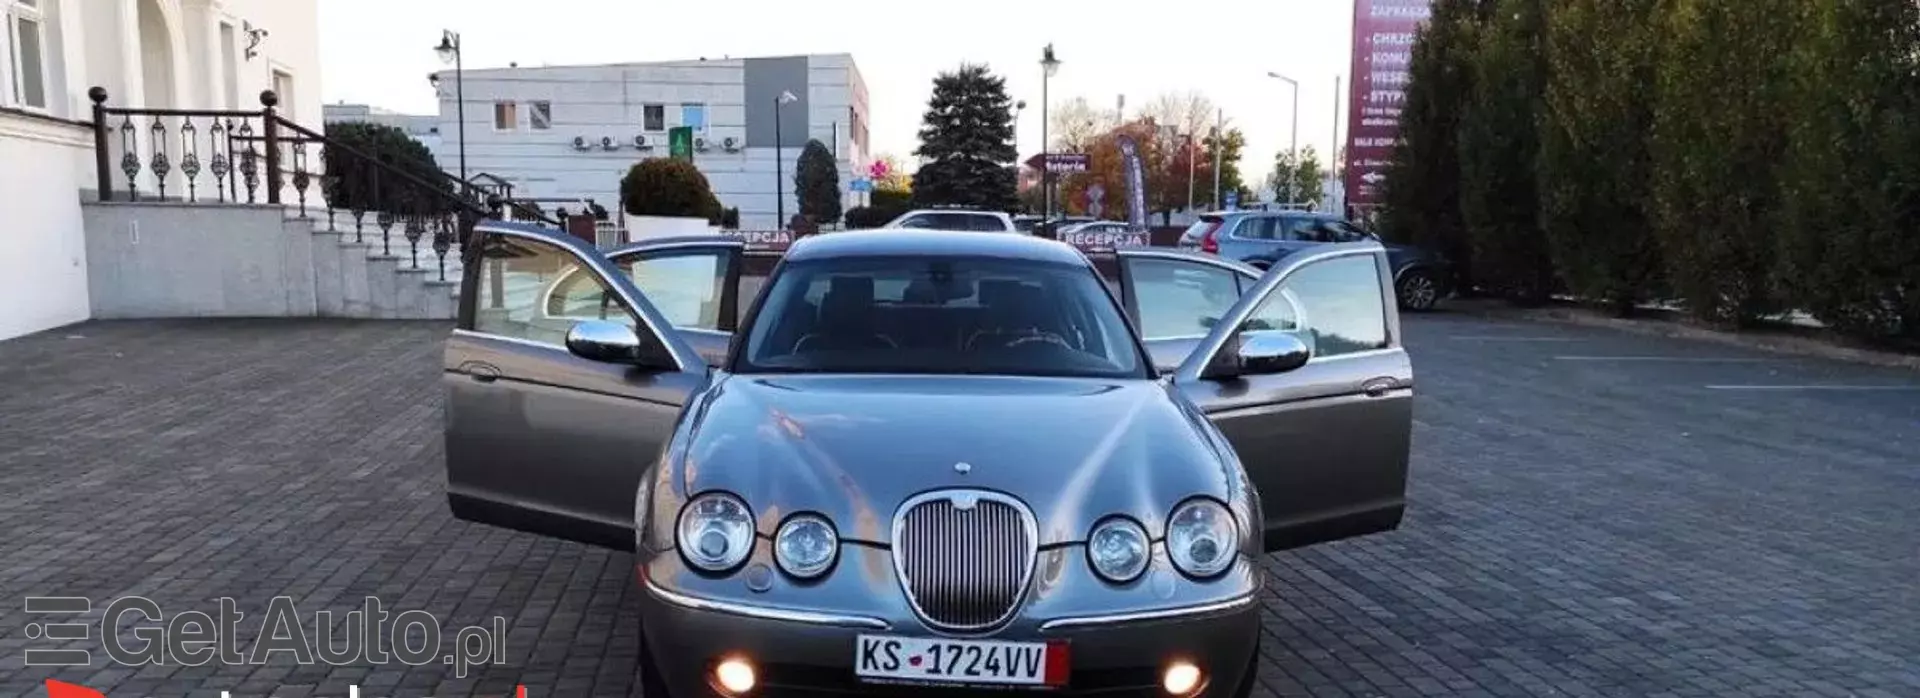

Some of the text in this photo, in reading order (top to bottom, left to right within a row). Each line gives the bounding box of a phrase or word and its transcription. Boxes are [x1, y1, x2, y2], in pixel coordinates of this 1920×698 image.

[1066, 232, 1143, 247] RECEPCJA
[861, 639, 1042, 678] KS 1724VV
